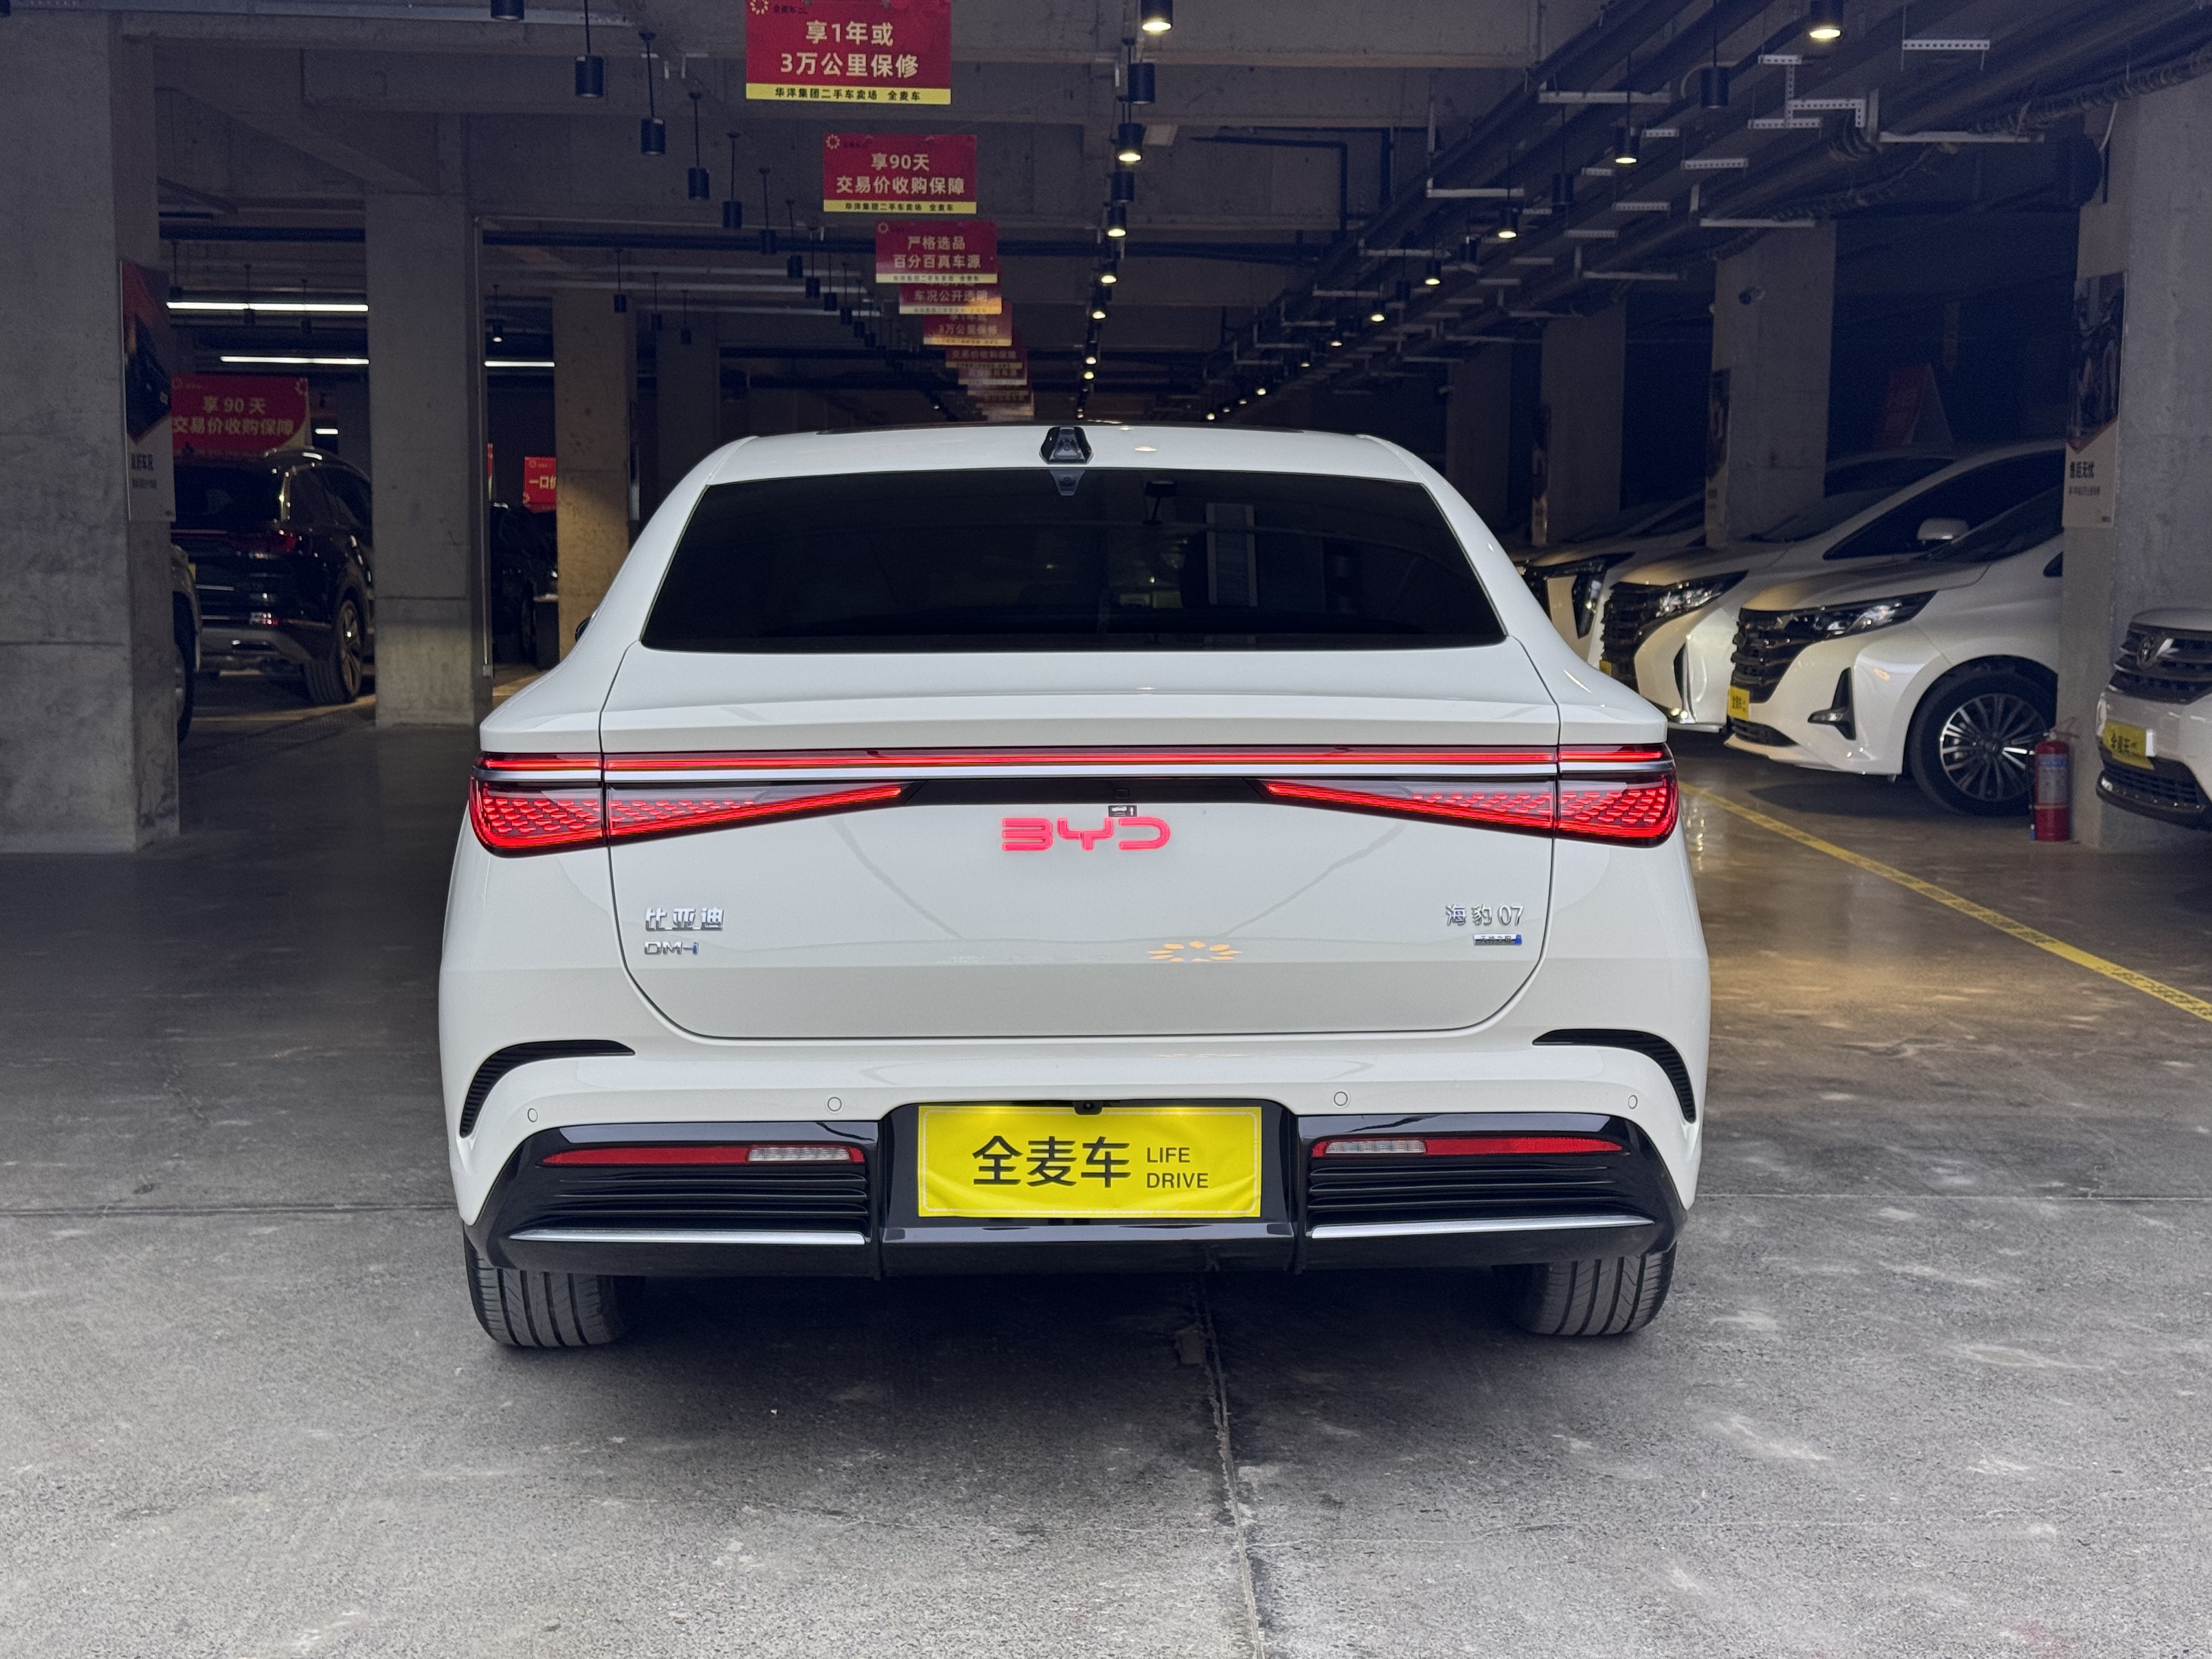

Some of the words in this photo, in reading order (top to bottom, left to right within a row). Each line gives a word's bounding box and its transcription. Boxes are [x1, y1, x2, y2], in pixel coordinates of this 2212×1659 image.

[805, 20, 894, 46] 享1年或
[780, 52, 919, 78] 3万公里保修
[775, 87, 878, 100] 华洋集团二手车卖场
[888, 90, 921, 101] 全麦车
[872, 153, 929, 171] 享90天
[837, 176, 965, 195] 交易价收购保障
[907, 236, 966, 250] 严格选品
[893, 254, 981, 269] 百分百真车源
[202, 395, 267, 414] 享90天
[173, 416, 294, 436] 交易价收购保障
[1002, 817, 1171, 851] BYD
[645, 907, 725, 932] 比亚迪
[644, 941, 699, 955] DM-i
[972, 1135, 1132, 1189] 全麦车
[1146, 1147, 1191, 1164] LIFE
[1146, 1172, 1210, 1189] DRIVE
